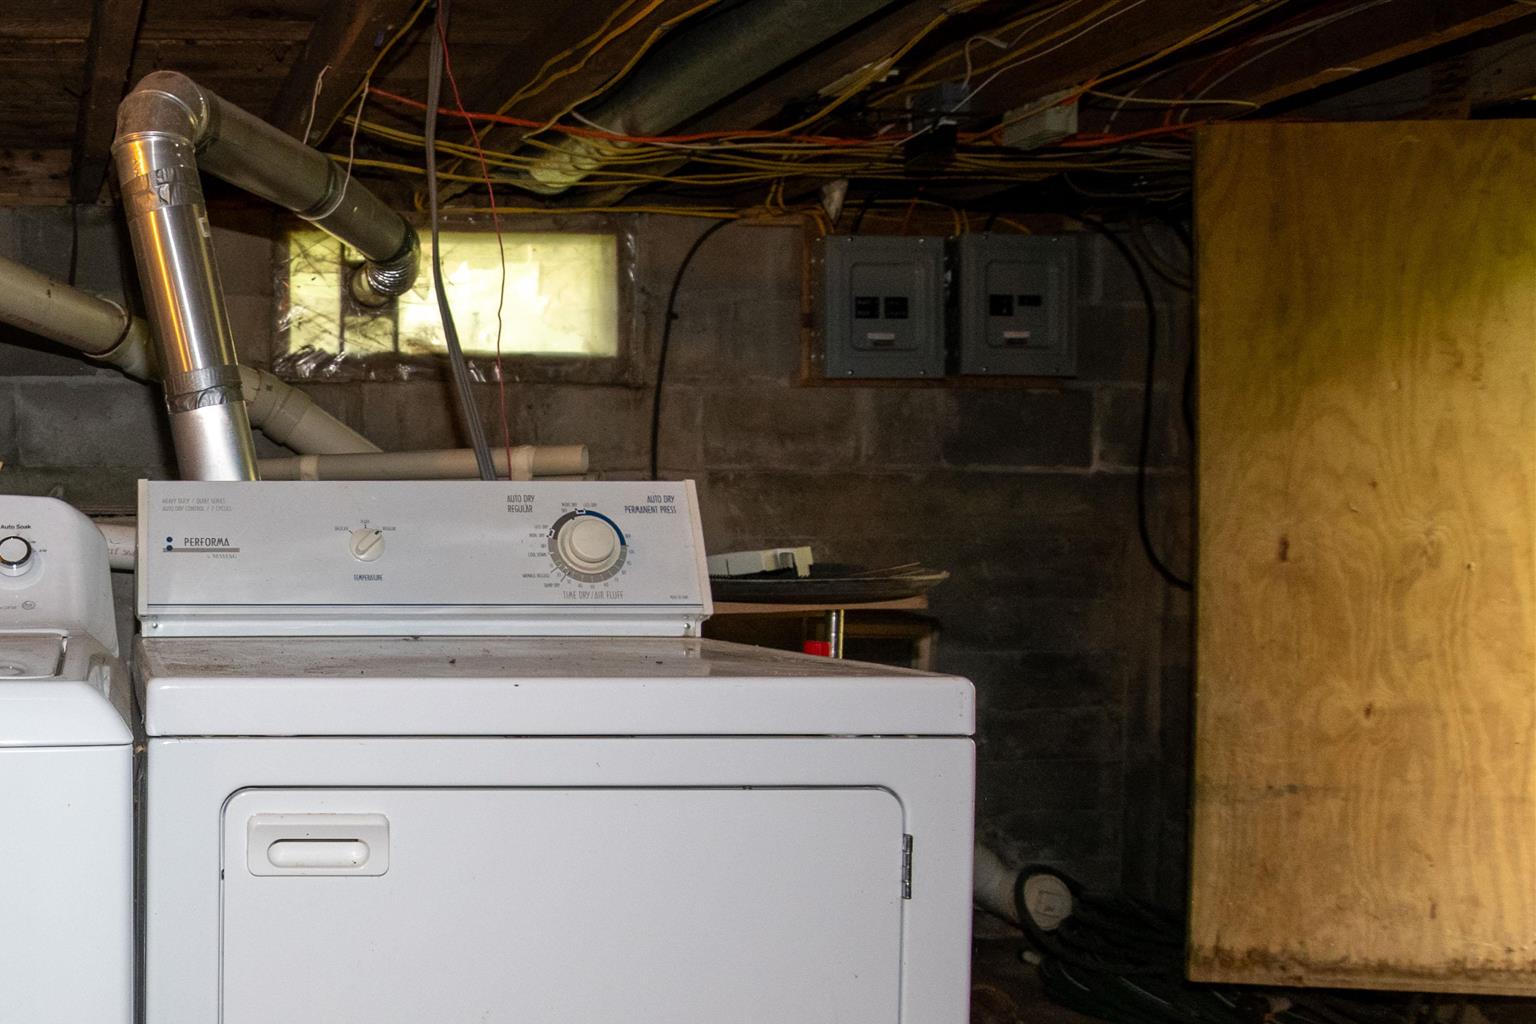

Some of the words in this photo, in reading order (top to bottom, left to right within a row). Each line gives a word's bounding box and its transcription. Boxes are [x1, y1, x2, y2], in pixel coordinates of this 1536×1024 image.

[507, 494, 522, 502] AUTO
[523, 494, 536, 502] DRY
[647, 495, 662, 503] AUTO
[663, 495, 675, 503] DRY
[507, 504, 533, 513] REGULAR
[624, 505, 658, 514] PERMANENT
[659, 505, 677, 514] PRESS
[184, 537, 230, 547] PERFORMA
[563, 590, 577, 600] TIME
[606, 590, 624, 600] FLUFF
